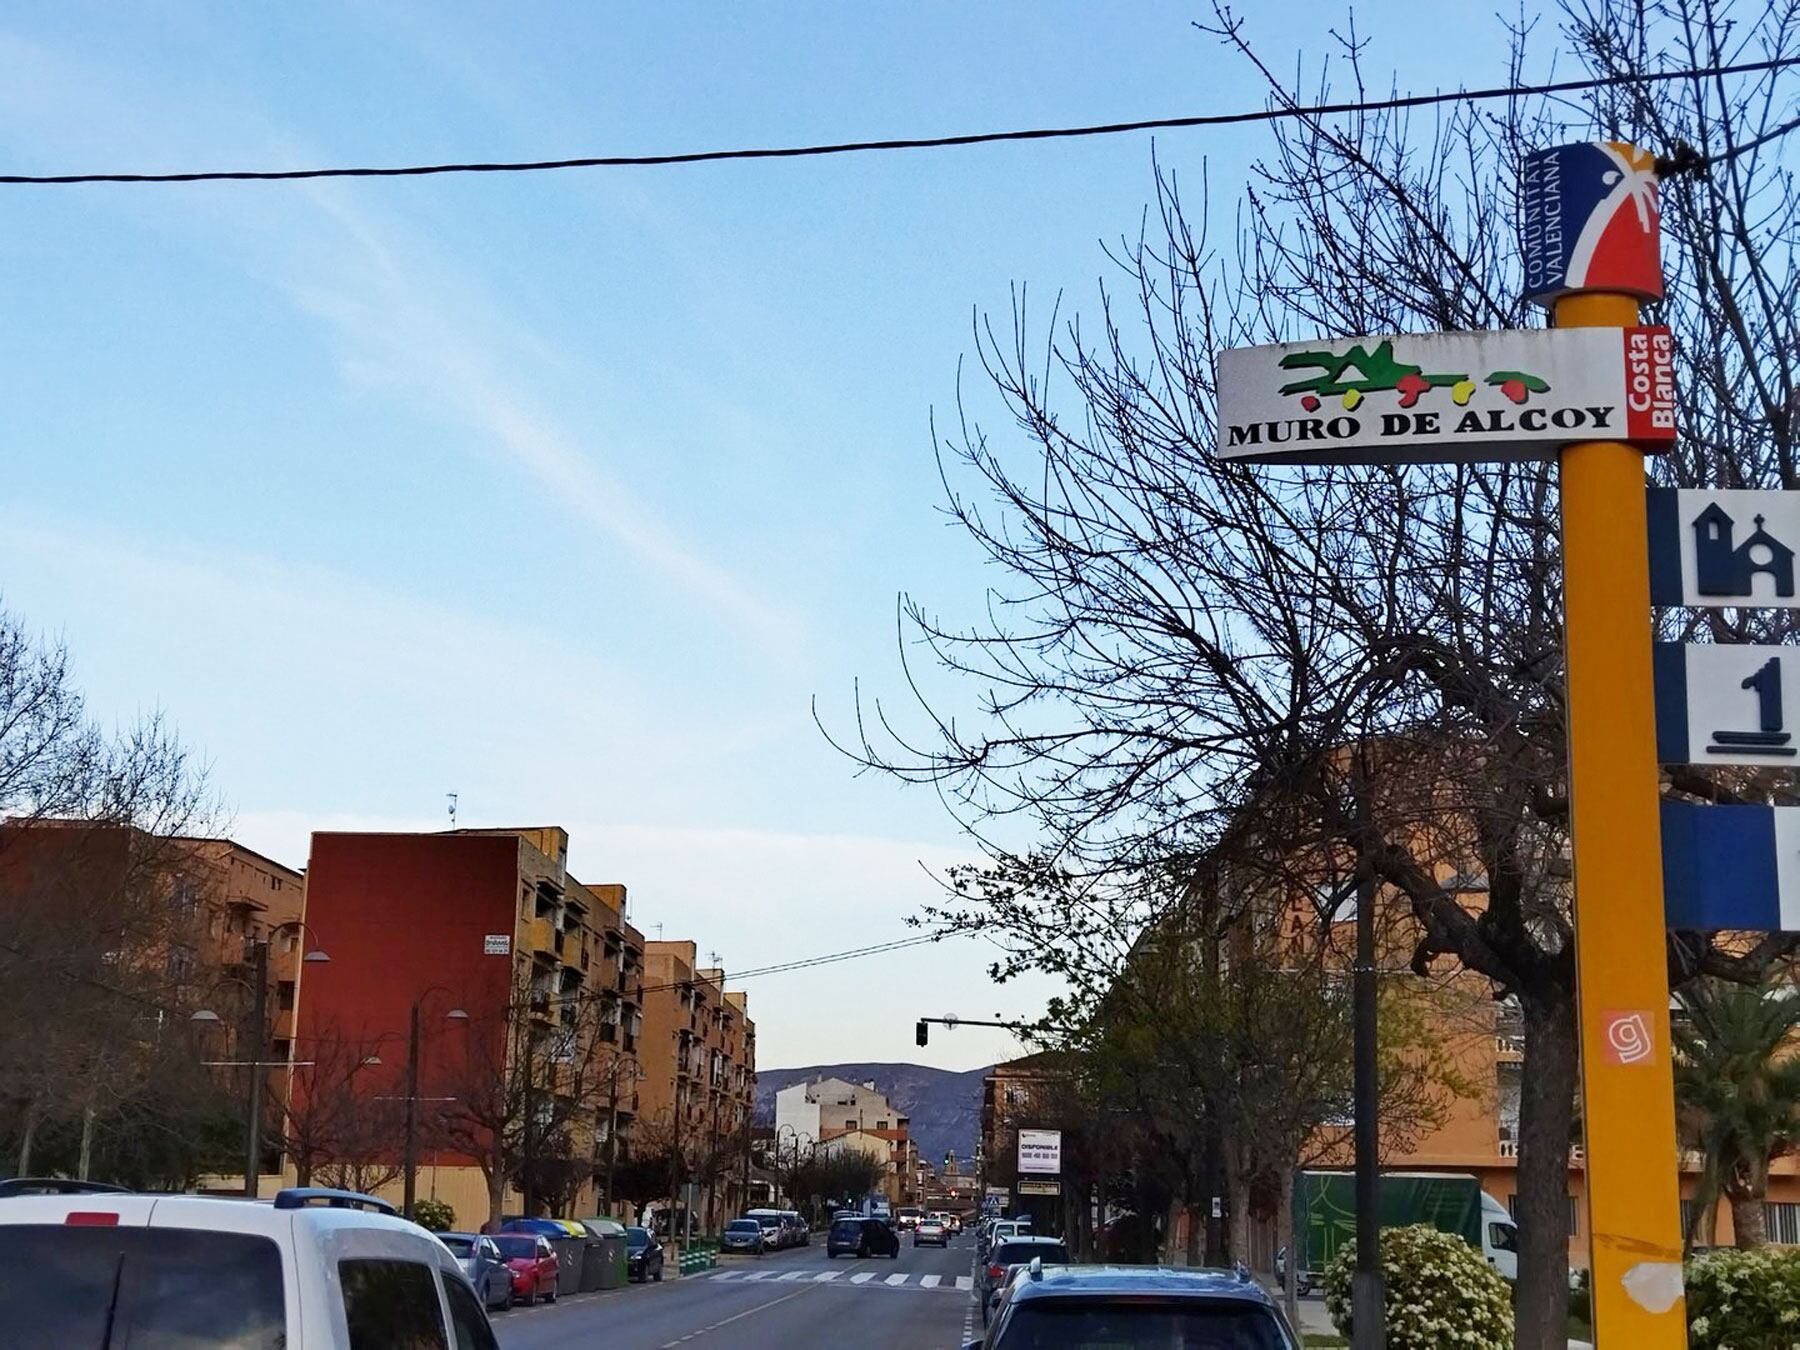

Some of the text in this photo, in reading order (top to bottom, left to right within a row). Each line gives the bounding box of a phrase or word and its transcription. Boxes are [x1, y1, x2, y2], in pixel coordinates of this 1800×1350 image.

[1526, 159, 1543, 288] COMUNITAT
[1543, 151, 1563, 285] VALENCIANA
[1628, 333, 1650, 412] Costa
[1651, 333, 1674, 429] Blanca
[1227, 406, 1615, 447] MURO DE ALCOY
